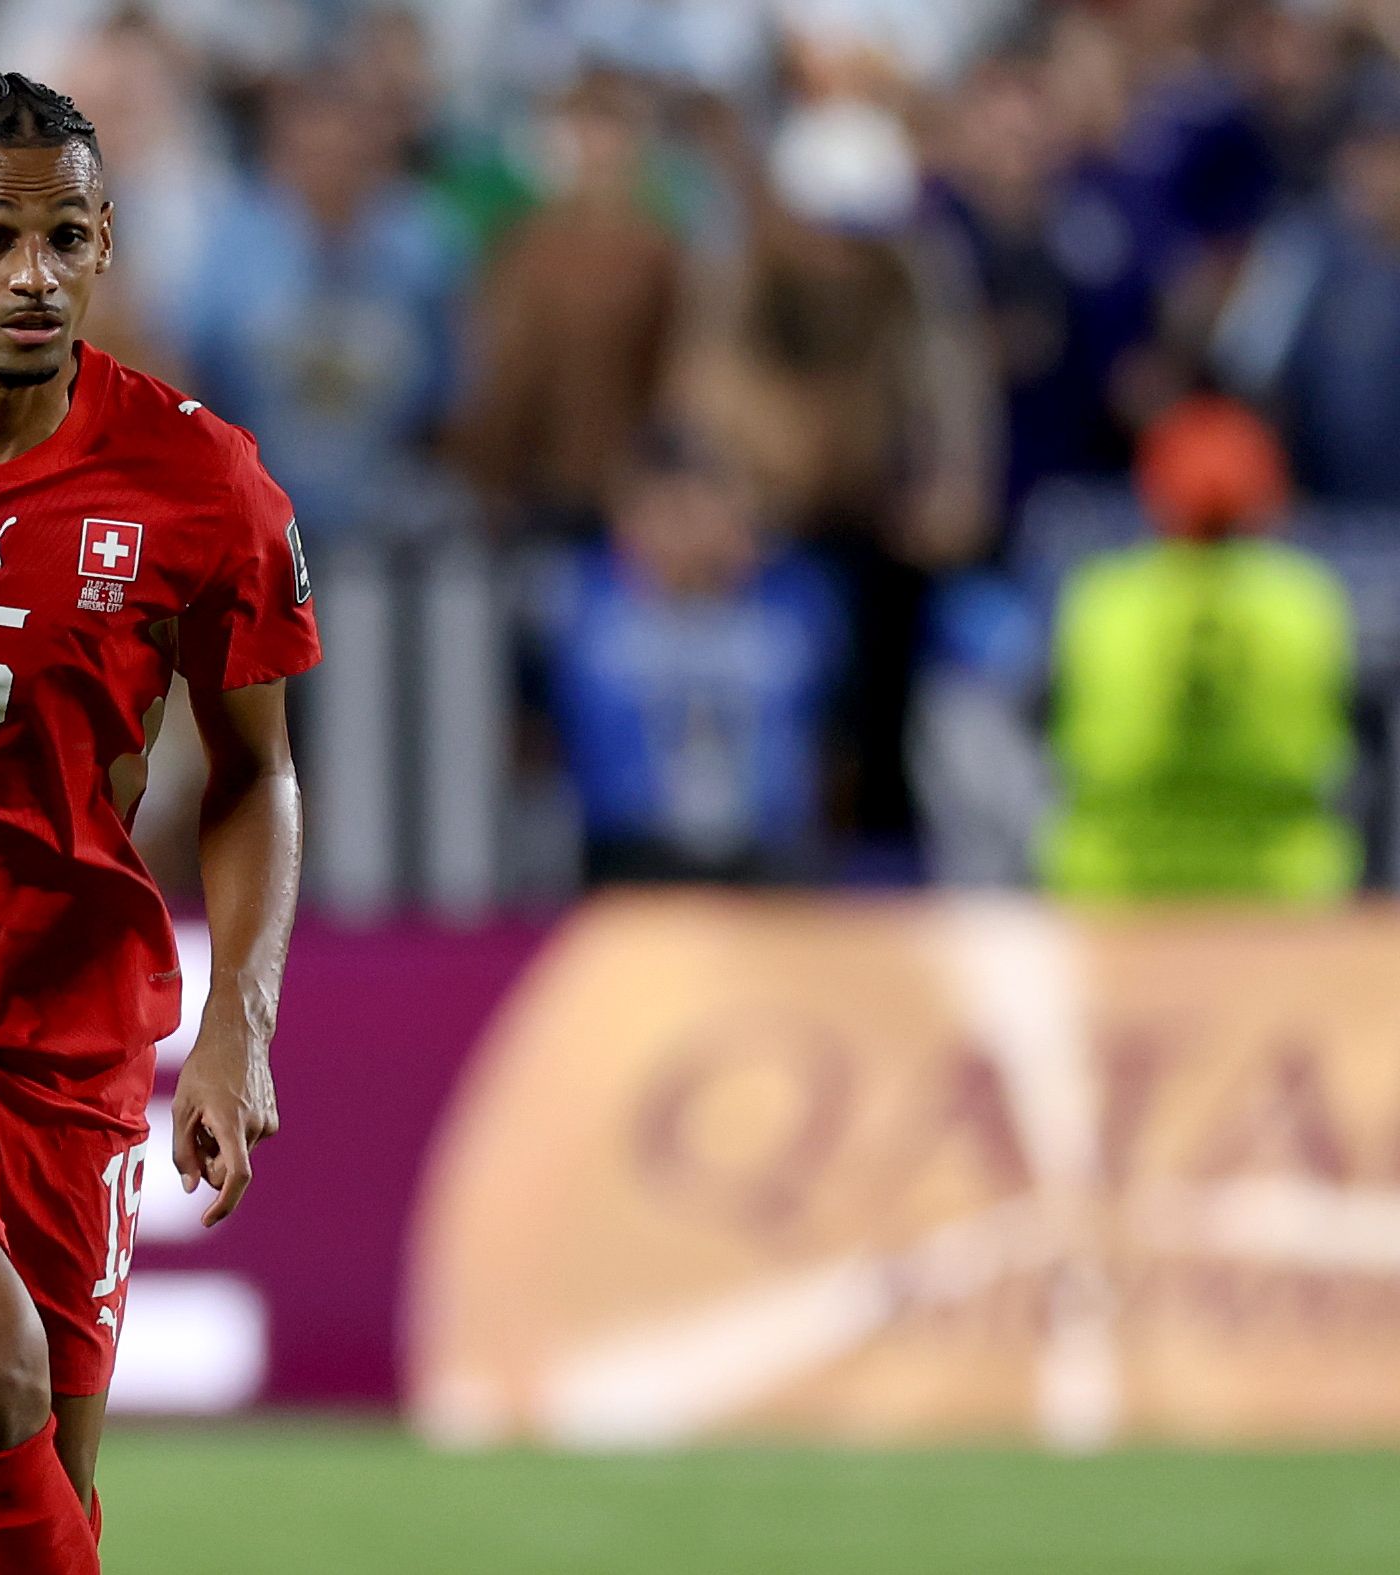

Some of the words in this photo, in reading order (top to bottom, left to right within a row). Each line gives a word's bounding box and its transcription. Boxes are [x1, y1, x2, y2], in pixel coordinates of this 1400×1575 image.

[80, 587, 100, 601] ARG
[107, 590, 124, 603] SUI
[106, 602, 124, 613] CITY
